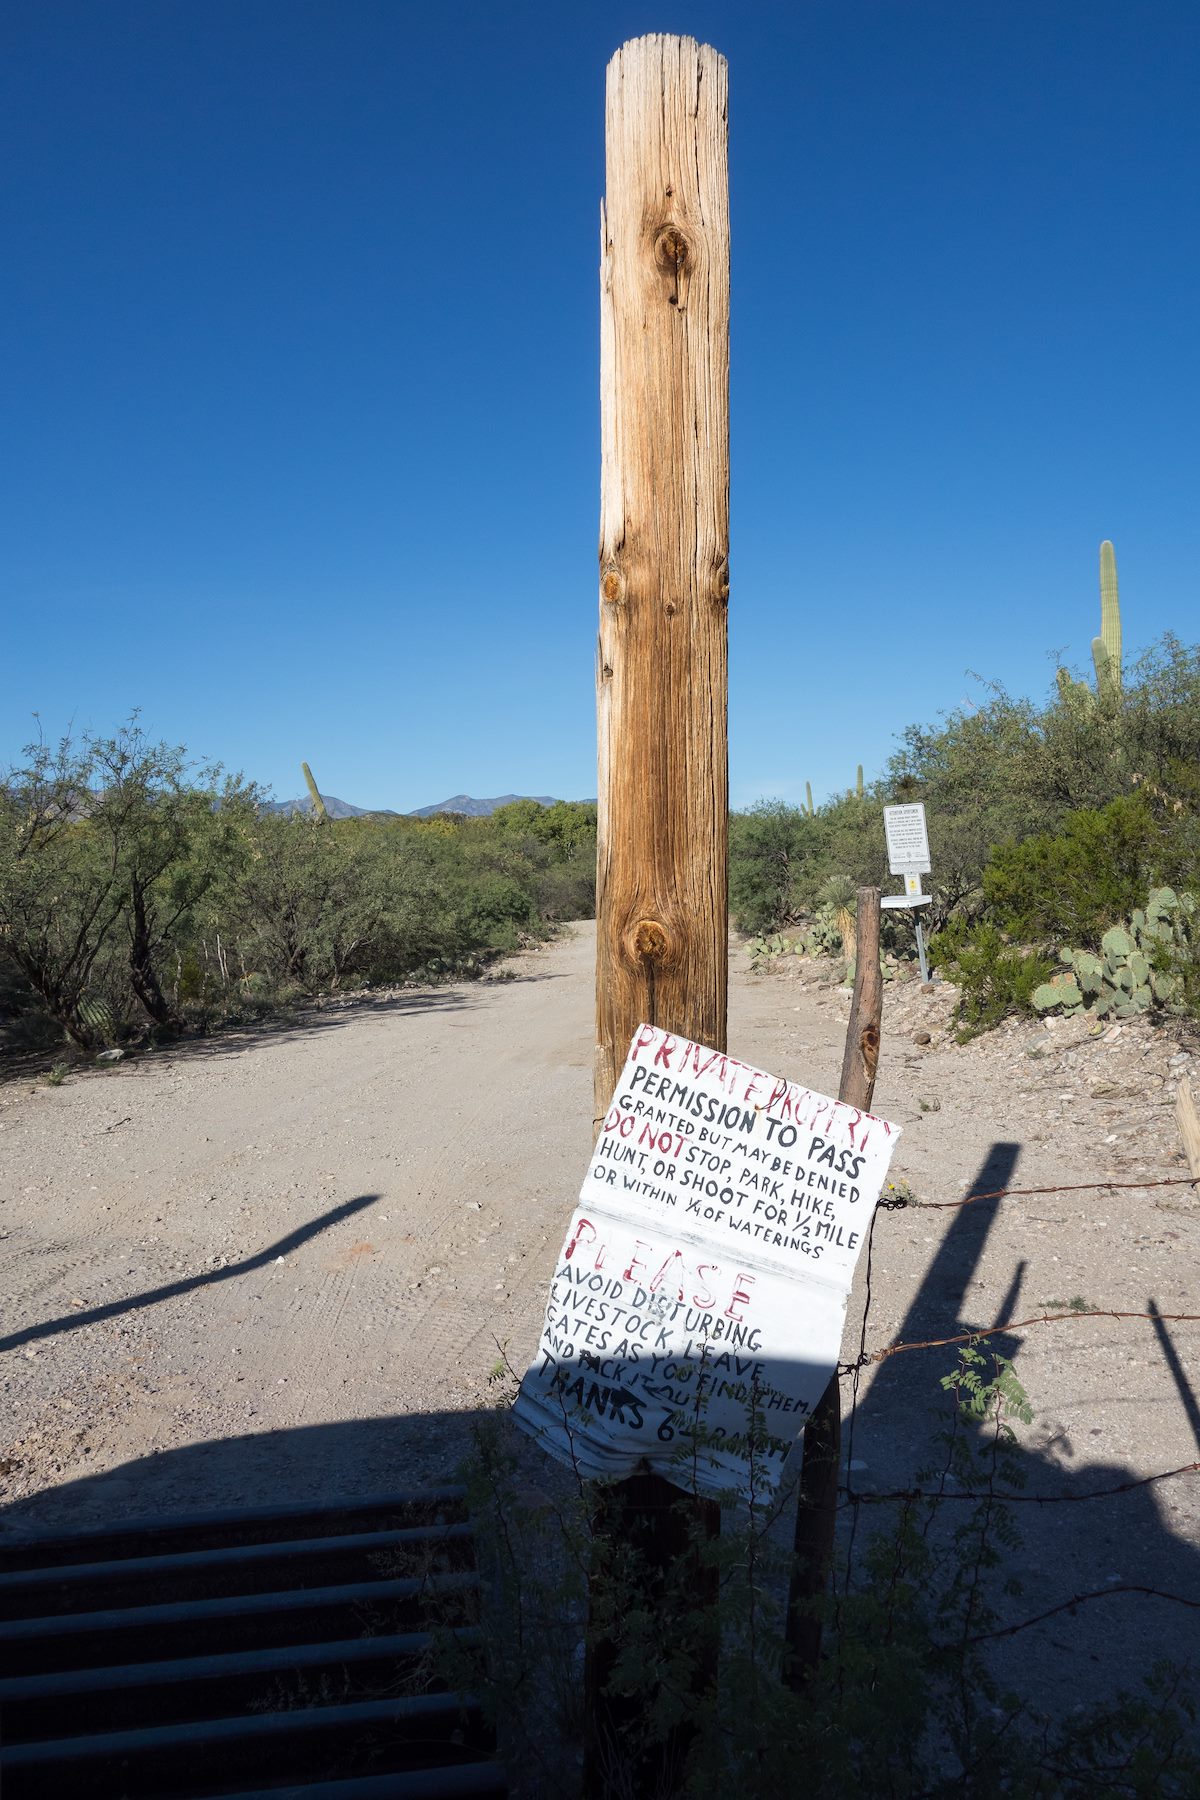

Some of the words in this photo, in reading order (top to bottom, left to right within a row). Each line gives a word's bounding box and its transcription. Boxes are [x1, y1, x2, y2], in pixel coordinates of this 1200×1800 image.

[631, 1024, 769, 1101] PRIVATE
[604, 1108, 634, 1138] DO
[638, 1122, 693, 1159] NOT
[686, 1147, 732, 1183] STOP,
[739, 1168, 785, 1204] PARK,
[790, 1188, 836, 1221] HIKE,
[619, 1095, 694, 1135] GRANTED
[698, 1125, 732, 1150] BUT
[736, 1142, 769, 1165] MAY
[770, 1157, 791, 1175] BE
[795, 1164, 860, 1203] DENIED
[630, 1066, 757, 1135] PERMISSION
[765, 1116, 797, 1147] TO
[808, 1137, 866, 1180] PASS
[593, 1165, 616, 1186] OR
[623, 1177, 677, 1206] WITHIN
[703, 1207, 726, 1222] OF
[729, 1215, 824, 1259] WATERINGS
[600, 1136, 648, 1175] HUNT,
[653, 1160, 675, 1180] OR
[680, 1170, 749, 1207] SHOOT
[753, 1200, 788, 1225] FOR
[814, 1222, 859, 1250] MILE
[556, 1264, 623, 1300] AVOID
[564, 1218, 757, 1323] PLEASE
[544, 1327, 574, 1358] AND
[547, 1305, 612, 1352] GATES
[613, 1339, 643, 1364] AS
[651, 1352, 693, 1383] YOU
[551, 1283, 673, 1359] LIVESTOCK,
[683, 1340, 765, 1381] LEAVE
[539, 1348, 646, 1429] THANKS
